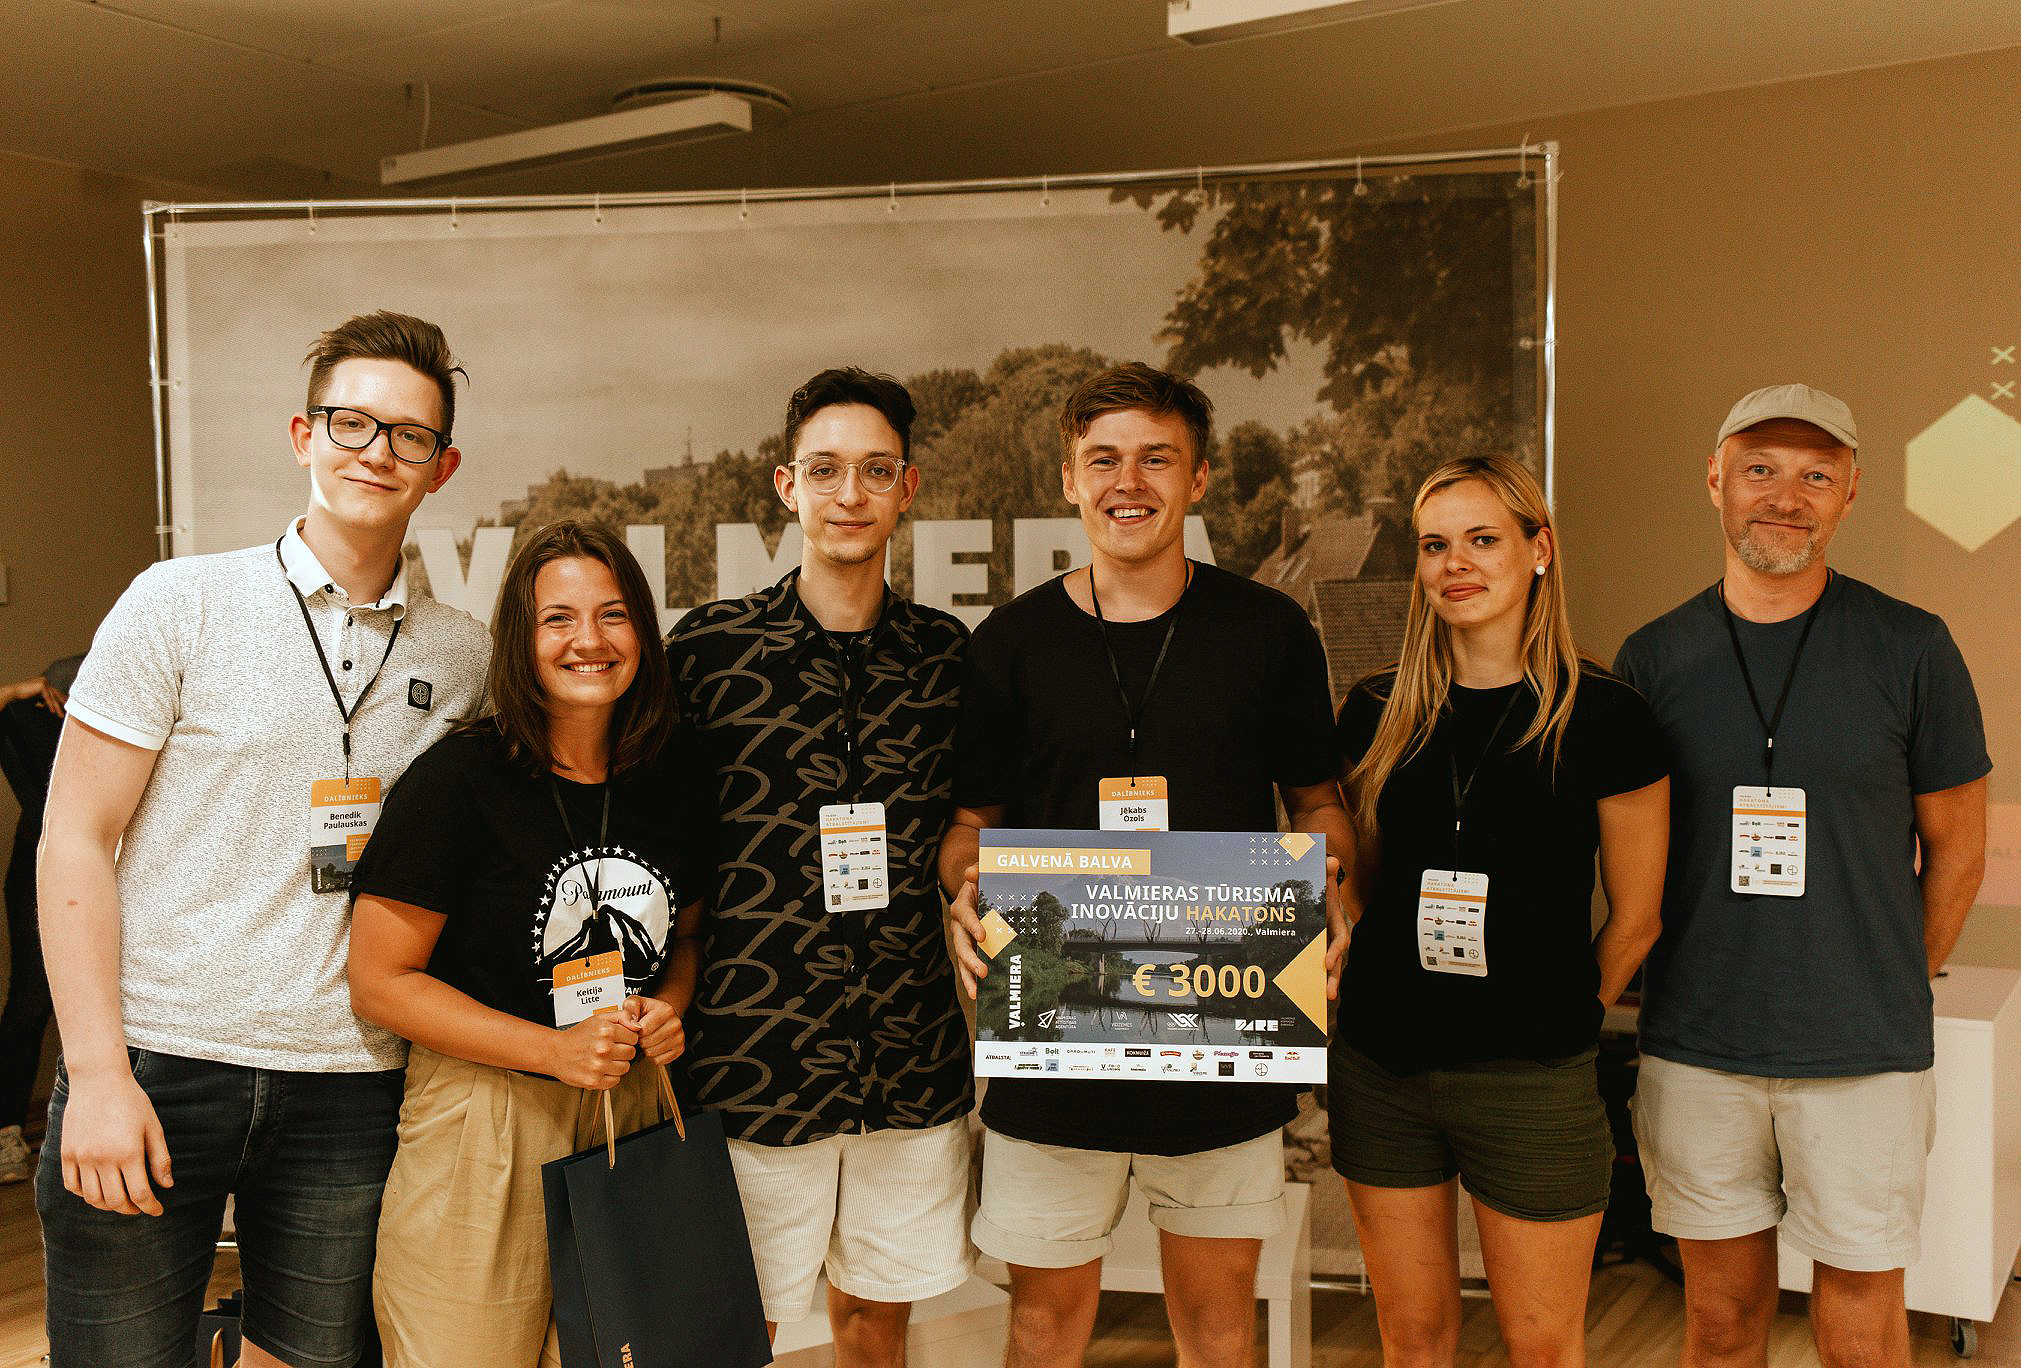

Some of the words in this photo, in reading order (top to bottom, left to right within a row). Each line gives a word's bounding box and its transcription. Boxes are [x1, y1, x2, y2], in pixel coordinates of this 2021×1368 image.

[330, 811, 362, 821] Benedik
[323, 820, 368, 830] Paulauskas
[996, 853, 1074, 868] GALVENĀ
[1079, 855, 1133, 869] BALVA
[1085, 884, 1199, 901] VALMIERAS
[1204, 883, 1296, 903] TŪRISMA
[1071, 902, 1179, 924] INOVĀCIJU
[1186, 905, 1296, 923] HAKATONS
[1255, 927, 1296, 937] Valmiera
[1132, 963, 1157, 997] €
[1168, 964, 1266, 999] 3000
[576, 985, 603, 998] Keitija
[1008, 954, 1023, 1030] VALMIERA
[581, 995, 600, 1005] Litte
[1045, 1047, 1059, 1056] Bolt
